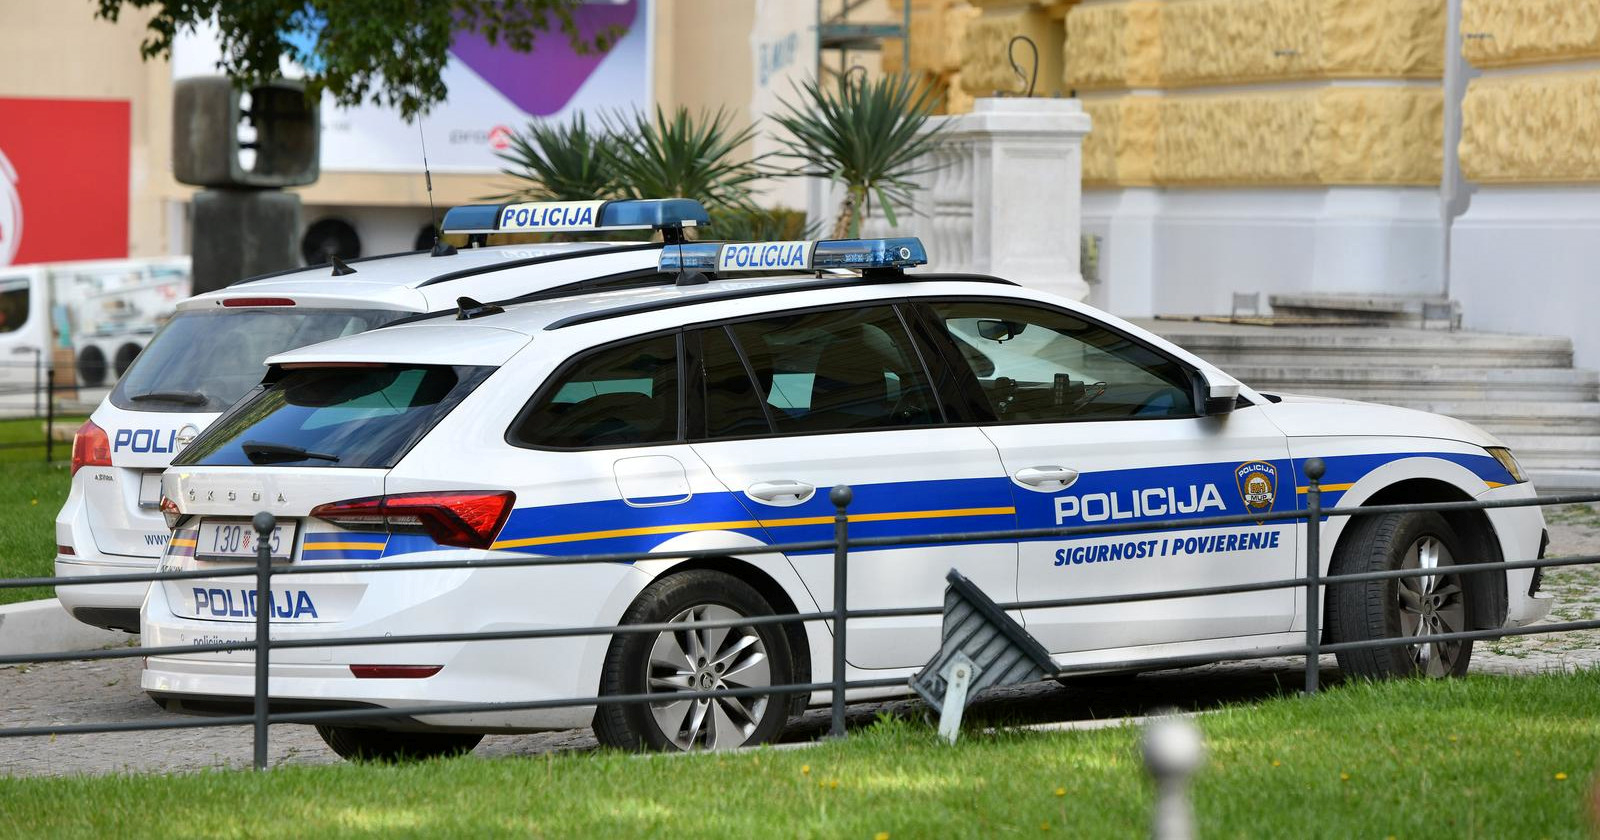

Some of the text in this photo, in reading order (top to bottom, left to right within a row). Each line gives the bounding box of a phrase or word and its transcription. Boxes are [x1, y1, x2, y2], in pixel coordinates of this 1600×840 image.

[502, 207, 592, 227] POLICIJA
[724, 245, 804, 267] POLICIJA
[1238, 464, 1274, 478] POLICIJA
[1054, 483, 1226, 525] POLICIJA
[213, 525, 241, 553] 130
[1054, 531, 1281, 566] SIGURNOST I POVJERENJE
